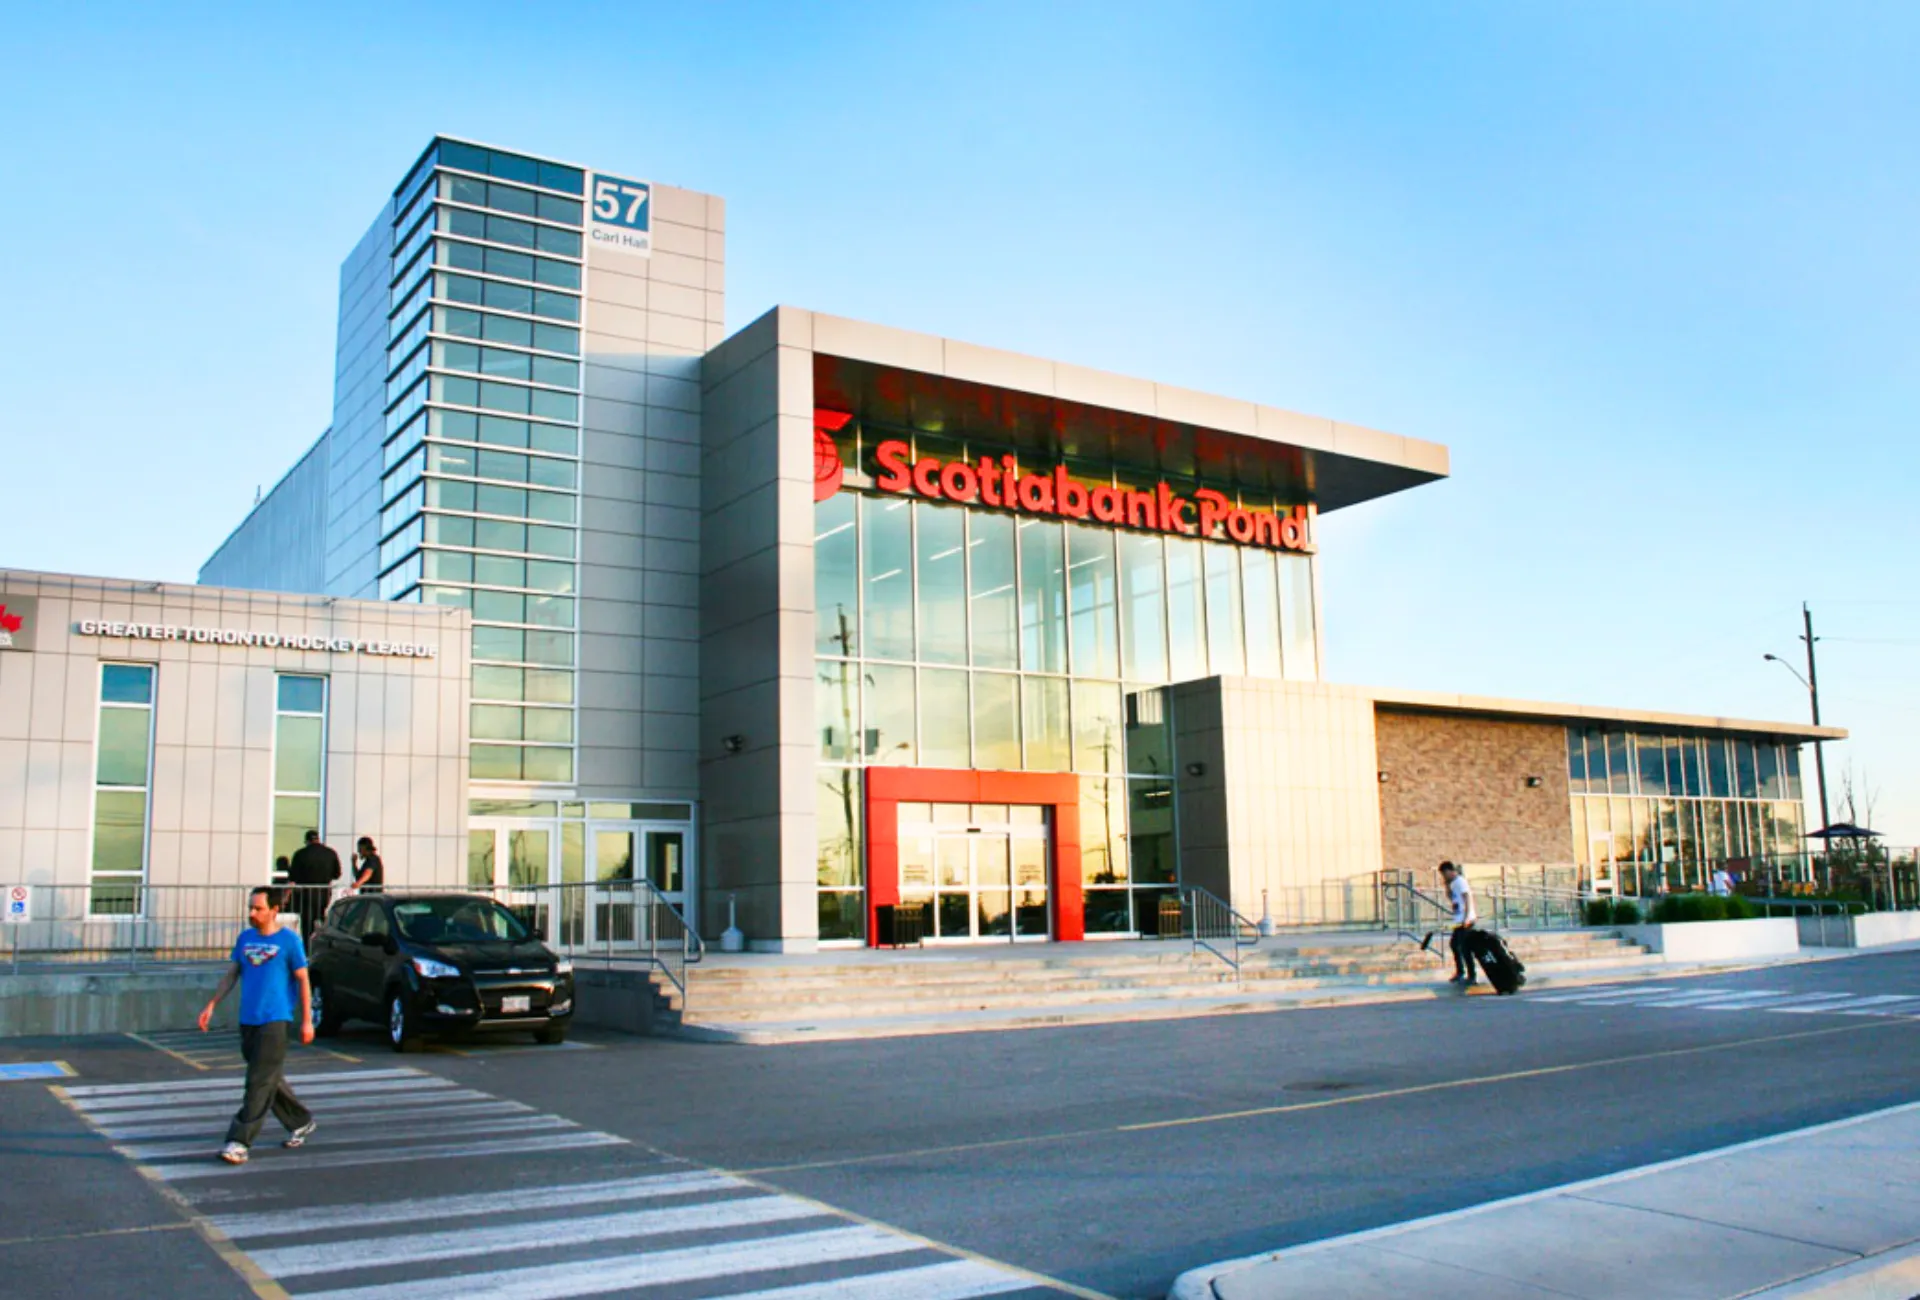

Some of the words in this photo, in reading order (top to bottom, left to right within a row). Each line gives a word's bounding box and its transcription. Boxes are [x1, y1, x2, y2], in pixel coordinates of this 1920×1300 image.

[594, 181, 647, 224] 57
[592, 229, 619, 244] Carl
[623, 235, 648, 249] Hall
[876, 440, 1187, 533] Scotiabank
[1194, 488, 1308, 550] Pond
[80, 620, 177, 639] GREATER
[182, 626, 280, 647] TORONTO
[283, 633, 362, 651] HOCKEY
[366, 639, 438, 658] LEAGUE
